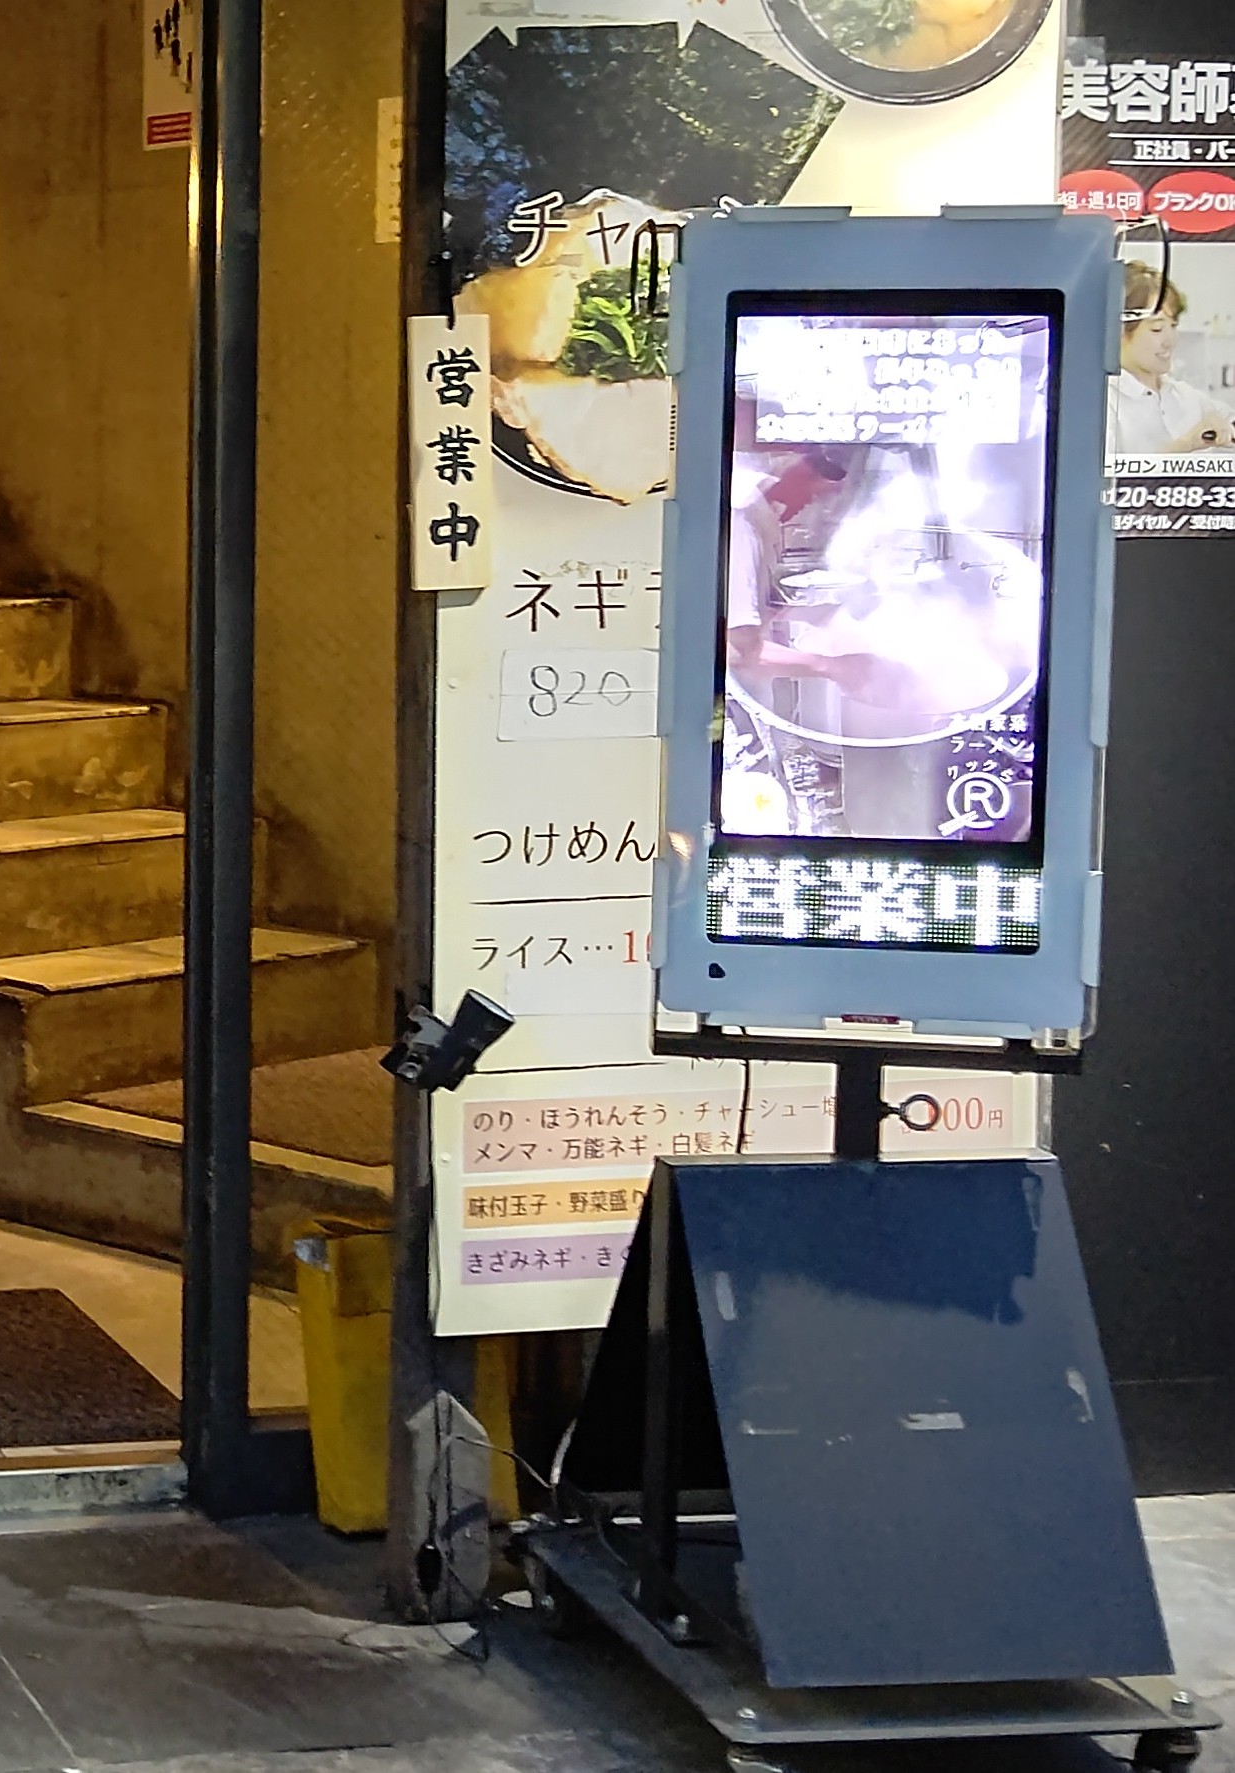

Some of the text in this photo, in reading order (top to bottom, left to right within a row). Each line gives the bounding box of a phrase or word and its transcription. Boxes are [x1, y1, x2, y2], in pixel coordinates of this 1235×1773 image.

[1061, 58, 1235, 124] 美容師
[426, 347, 482, 562] 営業中
[1162, 459, 1233, 474] IWASAKI
[1102, 486, 1235, 508] 120-888-33
[528, 665, 632, 717] 820
[473, 820, 656, 868] つけめん
[707, 857, 1043, 947] 営業中
